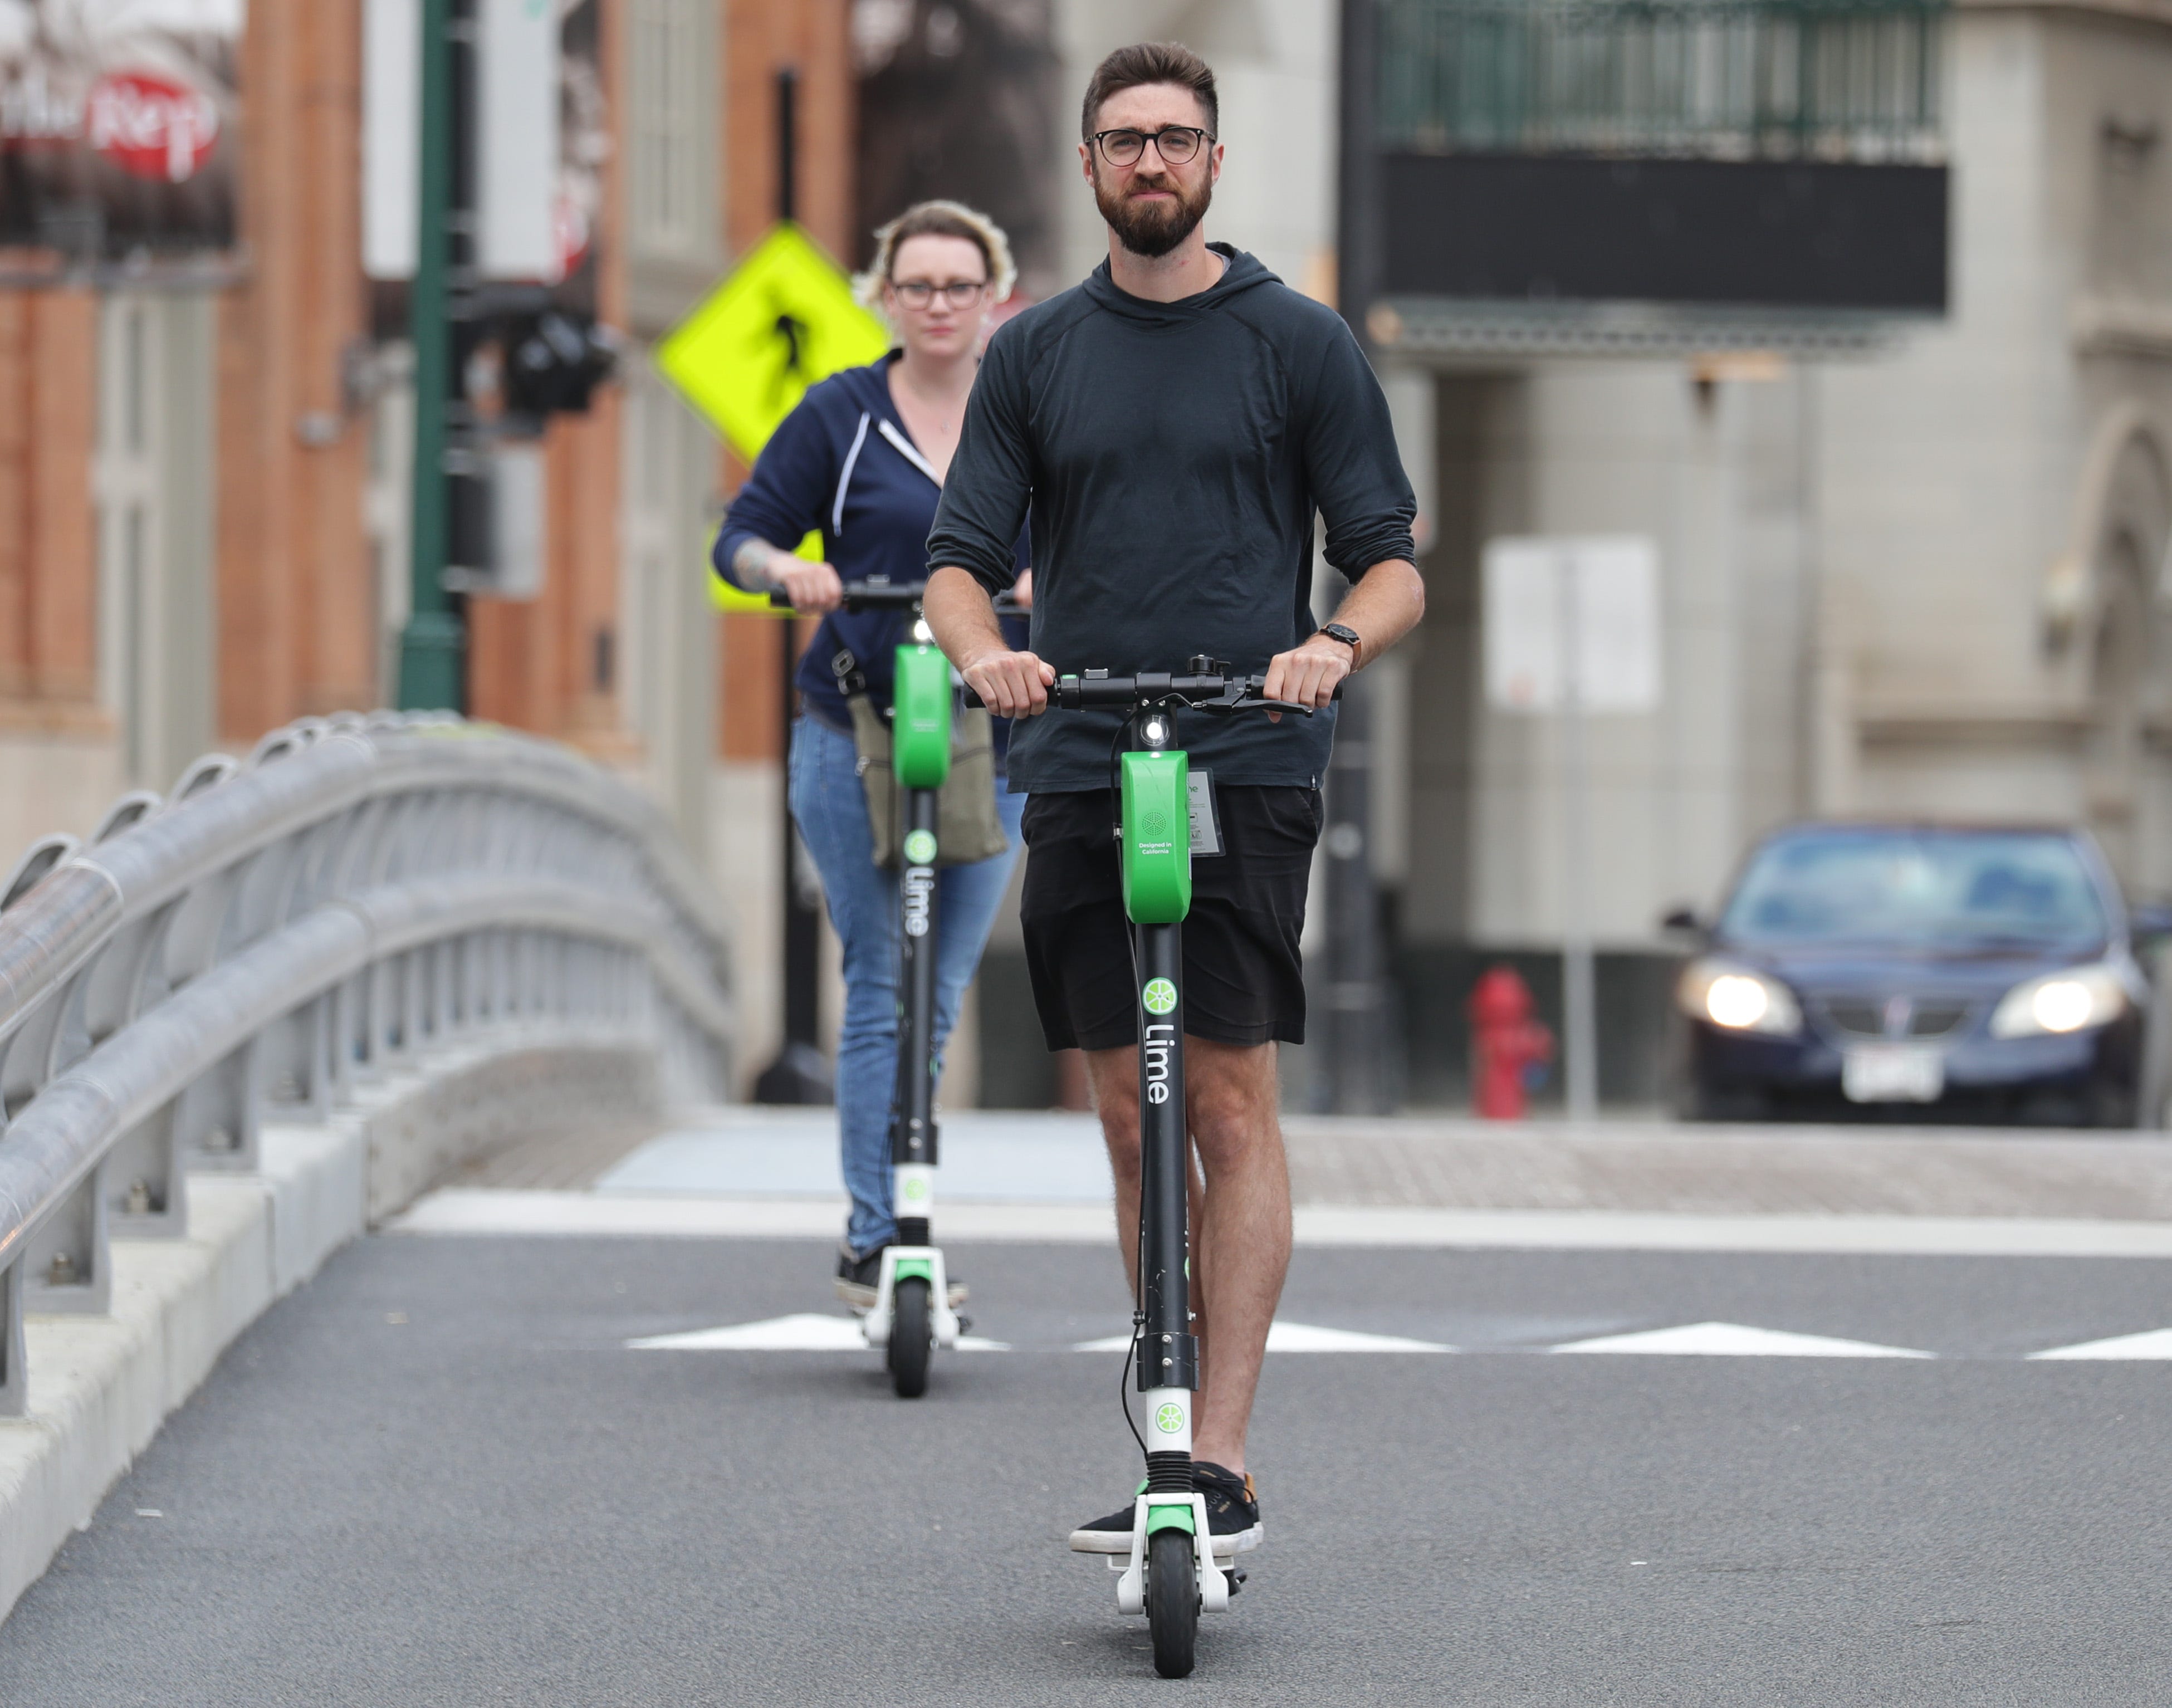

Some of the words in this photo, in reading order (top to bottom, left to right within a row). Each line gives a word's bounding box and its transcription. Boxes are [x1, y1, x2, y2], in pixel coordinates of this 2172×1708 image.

[91, 80, 219, 184] Rep
[905, 867, 935, 937] Lime
[1146, 1024, 1175, 1104] Lime
